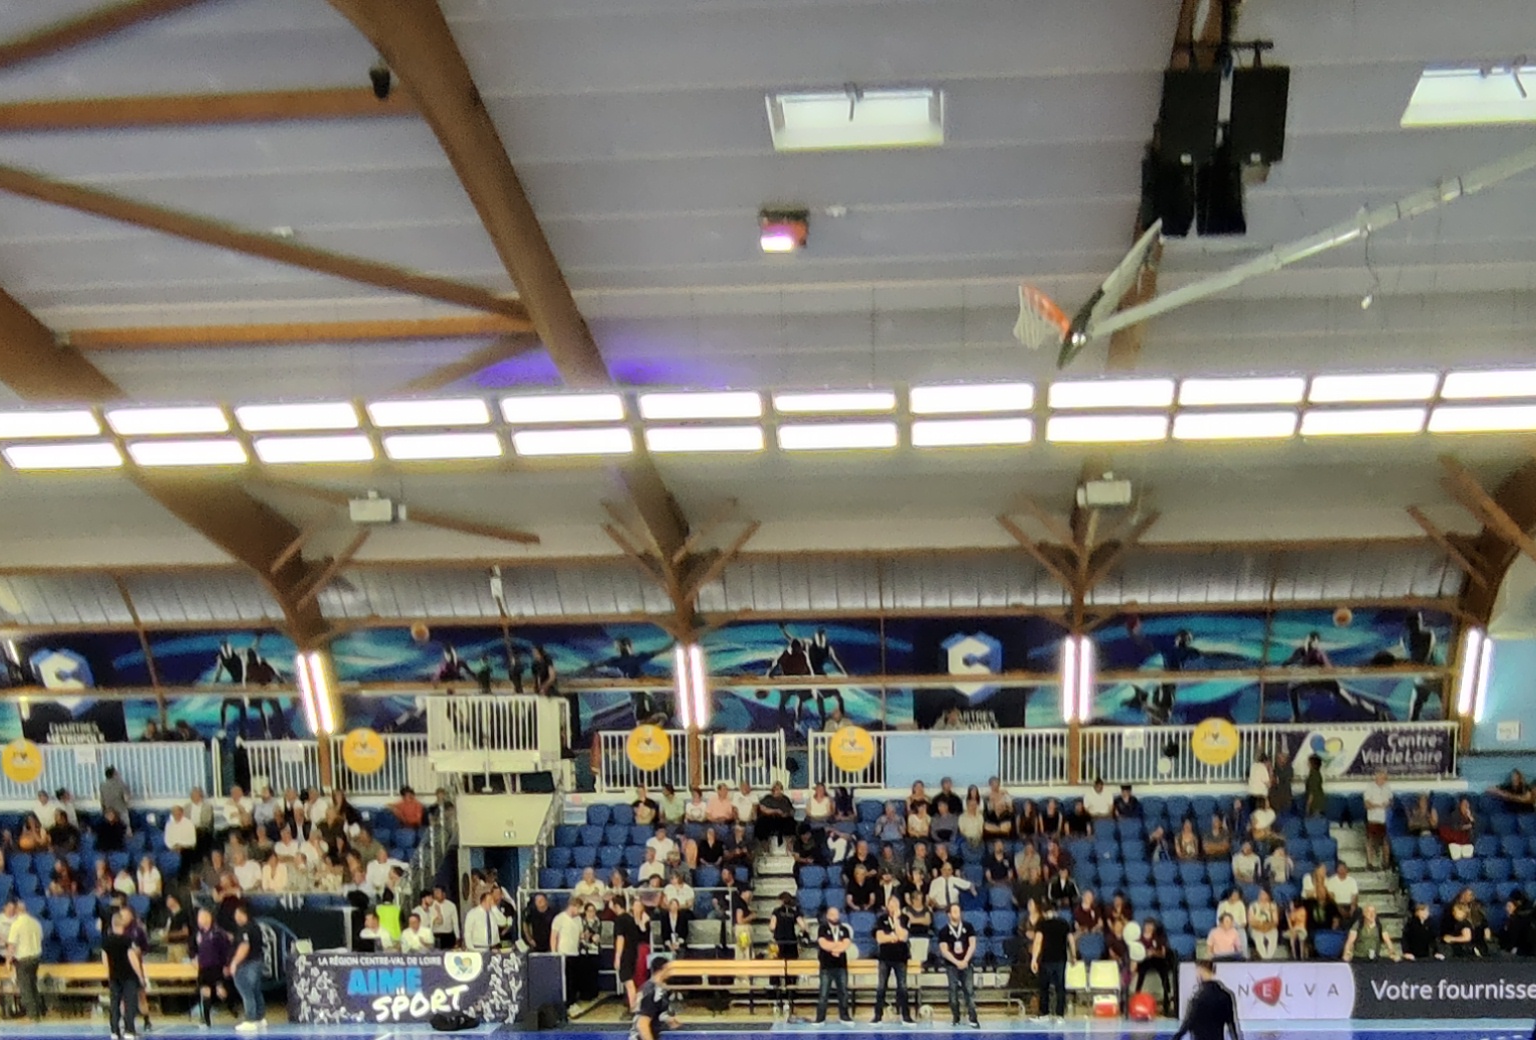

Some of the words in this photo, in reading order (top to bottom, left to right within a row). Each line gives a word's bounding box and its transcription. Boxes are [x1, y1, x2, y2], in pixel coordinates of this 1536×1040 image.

[1361, 749, 1385, 765] Val
[1405, 749, 1442, 764] Loire
[318, 956, 329, 966] LA
[329, 955, 359, 966] RÉGION
[348, 966, 423, 996] AIME
[1371, 979, 1433, 1000] Votre
[372, 985, 470, 1022] SPORT
